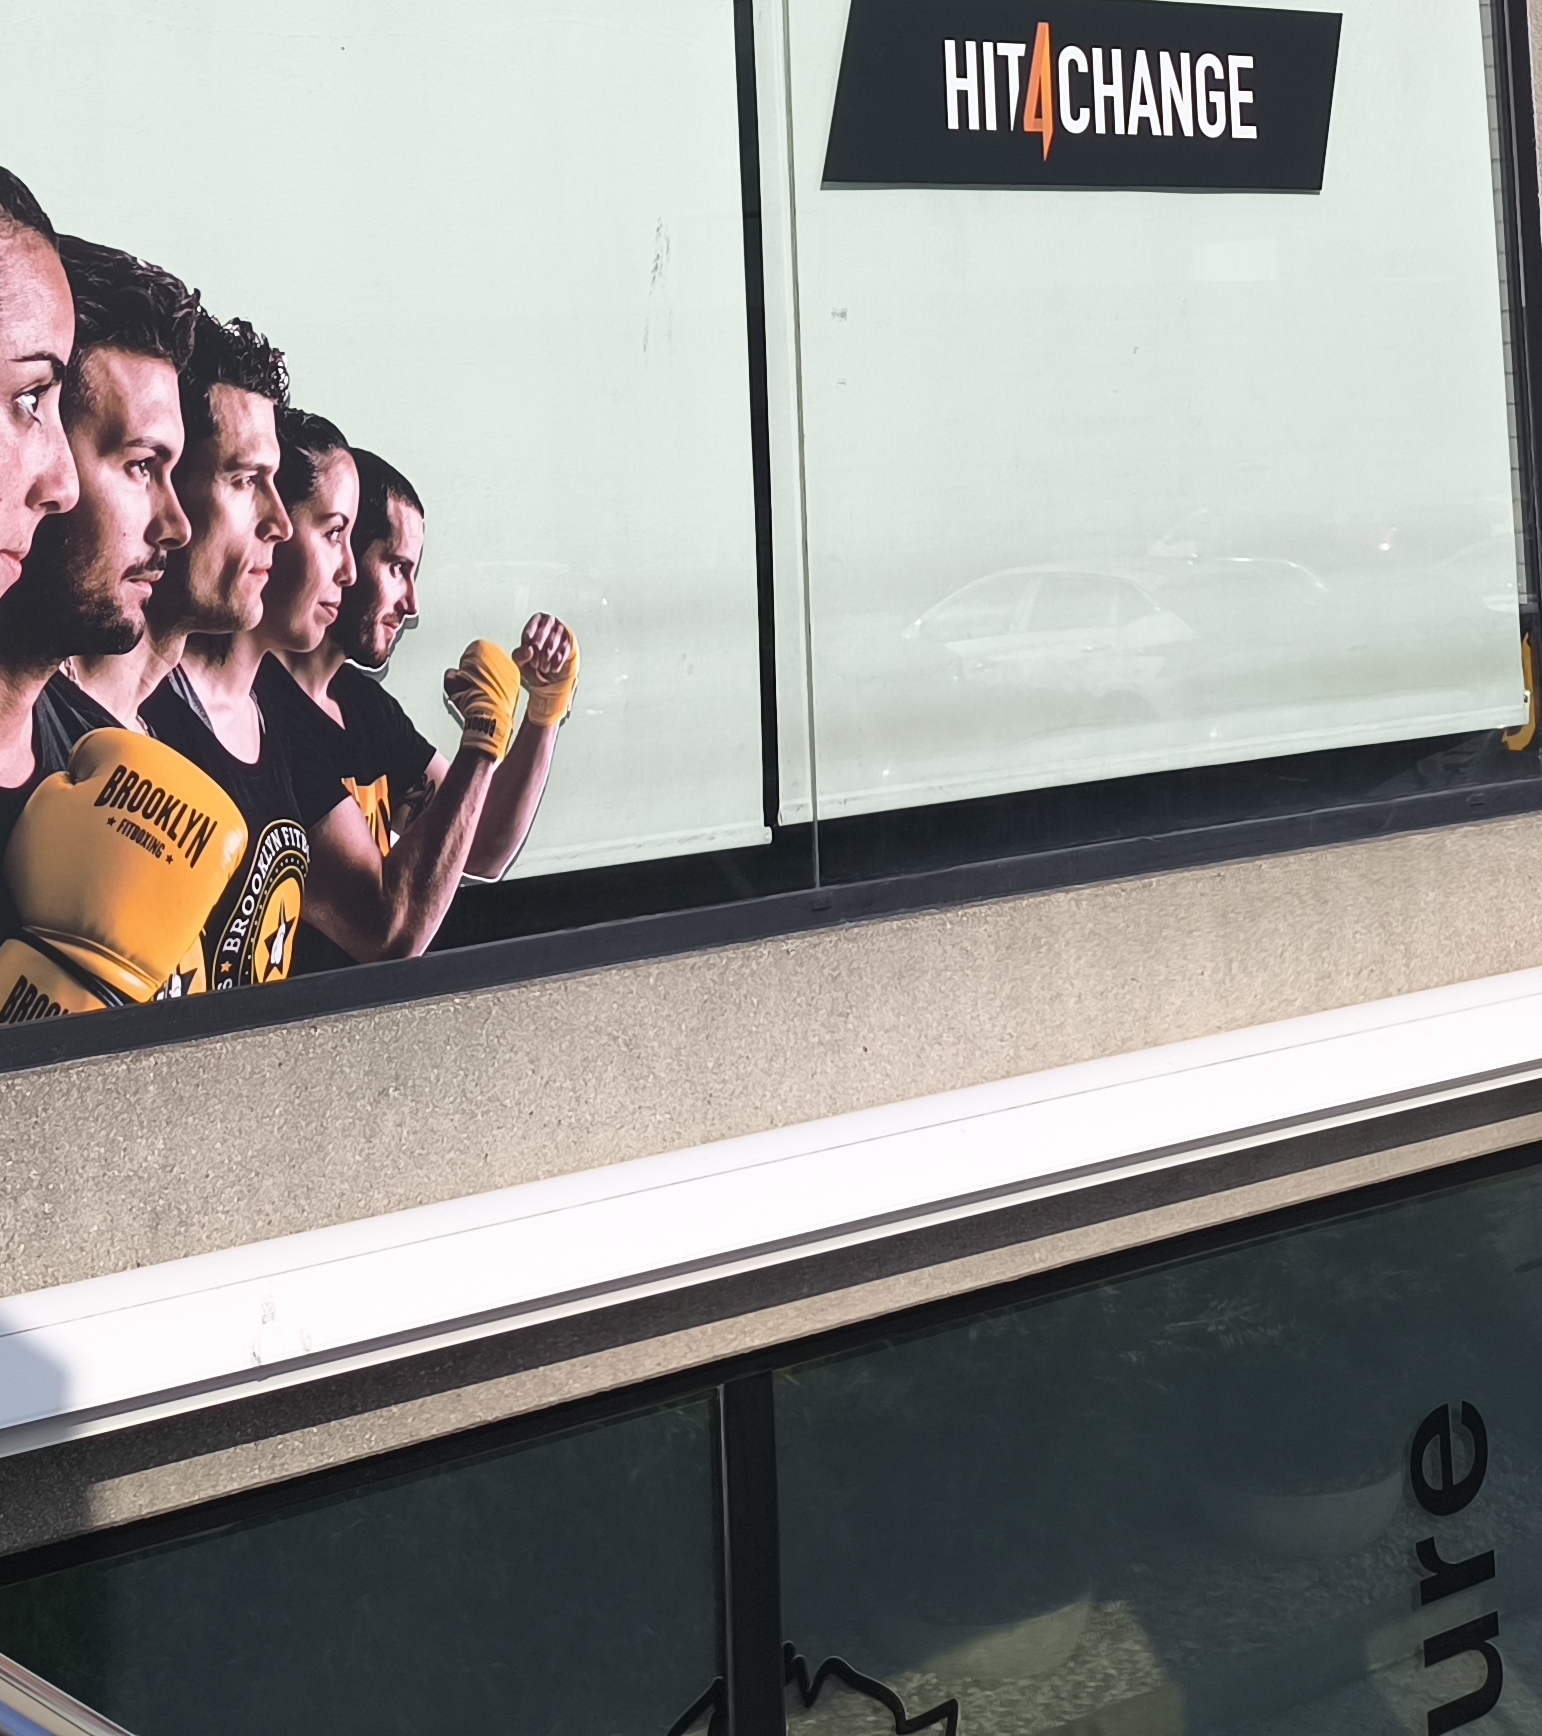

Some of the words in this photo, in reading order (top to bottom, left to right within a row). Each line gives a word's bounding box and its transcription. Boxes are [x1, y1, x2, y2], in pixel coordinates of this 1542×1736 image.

[94, 764, 218, 869] BROOKLYN
[116, 818, 167, 860] FITBOXING
[222, 828, 283, 954] BROOKLYN
